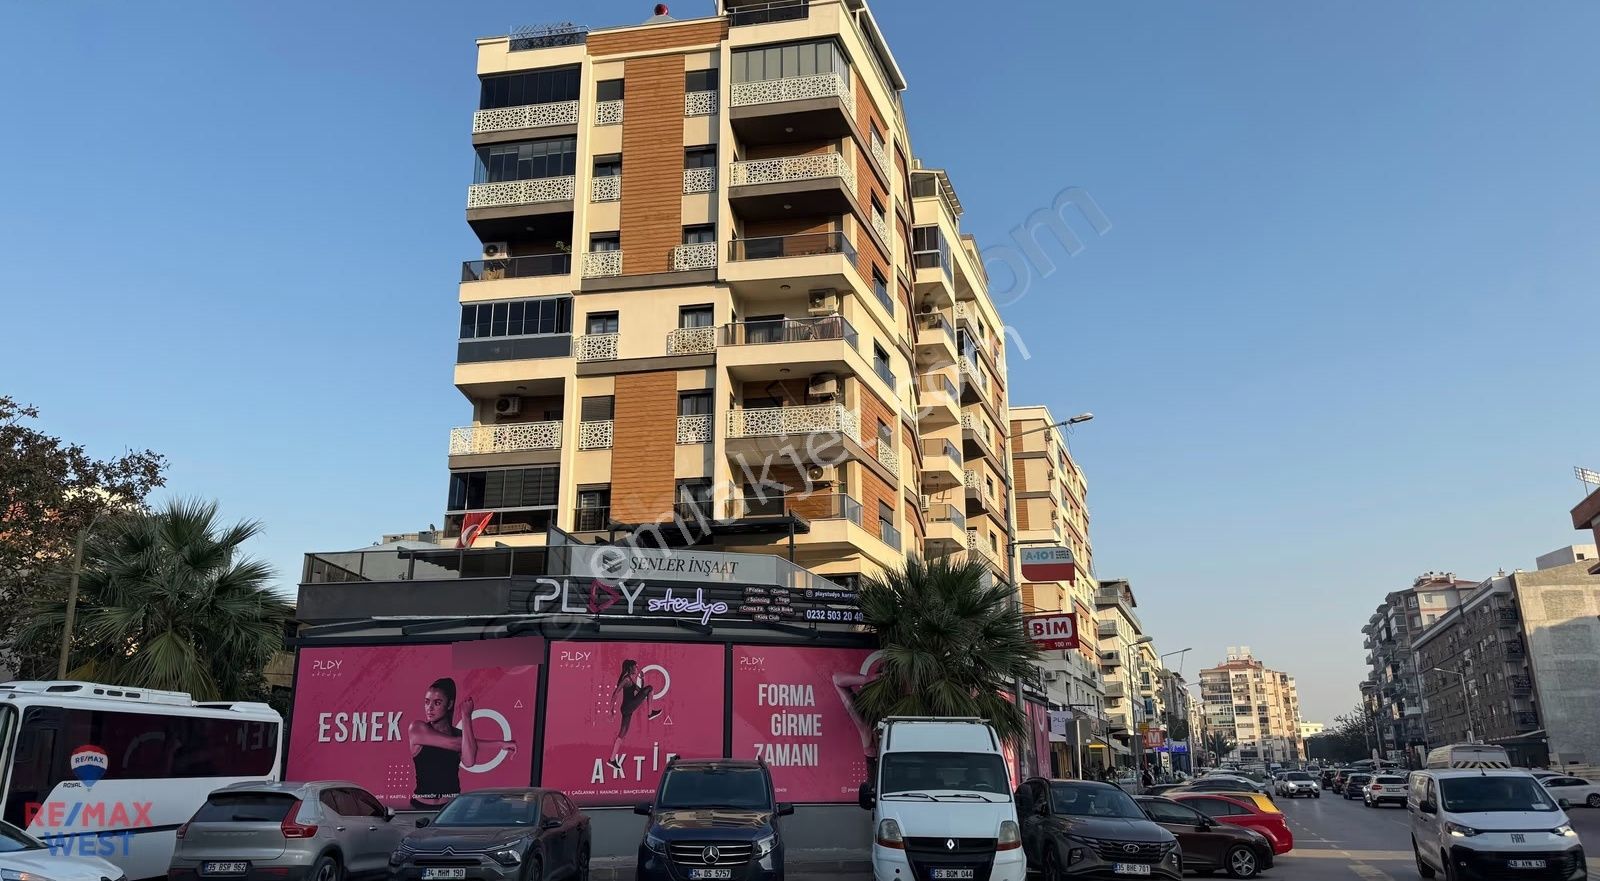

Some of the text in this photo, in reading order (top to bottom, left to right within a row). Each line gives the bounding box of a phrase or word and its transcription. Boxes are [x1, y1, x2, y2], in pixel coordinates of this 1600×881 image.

[630, 556, 739, 576] ŞENLER İNŞAAT
[648, 588, 728, 625] stüdyo
[806, 609, 826, 620] 0232
[827, 610, 841, 621] 503
[843, 611, 853, 621] 20
[758, 684, 815, 707] FORMA
[318, 711, 403, 742] ESNEK
[771, 710, 822, 736] GİRME
[753, 743, 818, 767] ZAMANI
